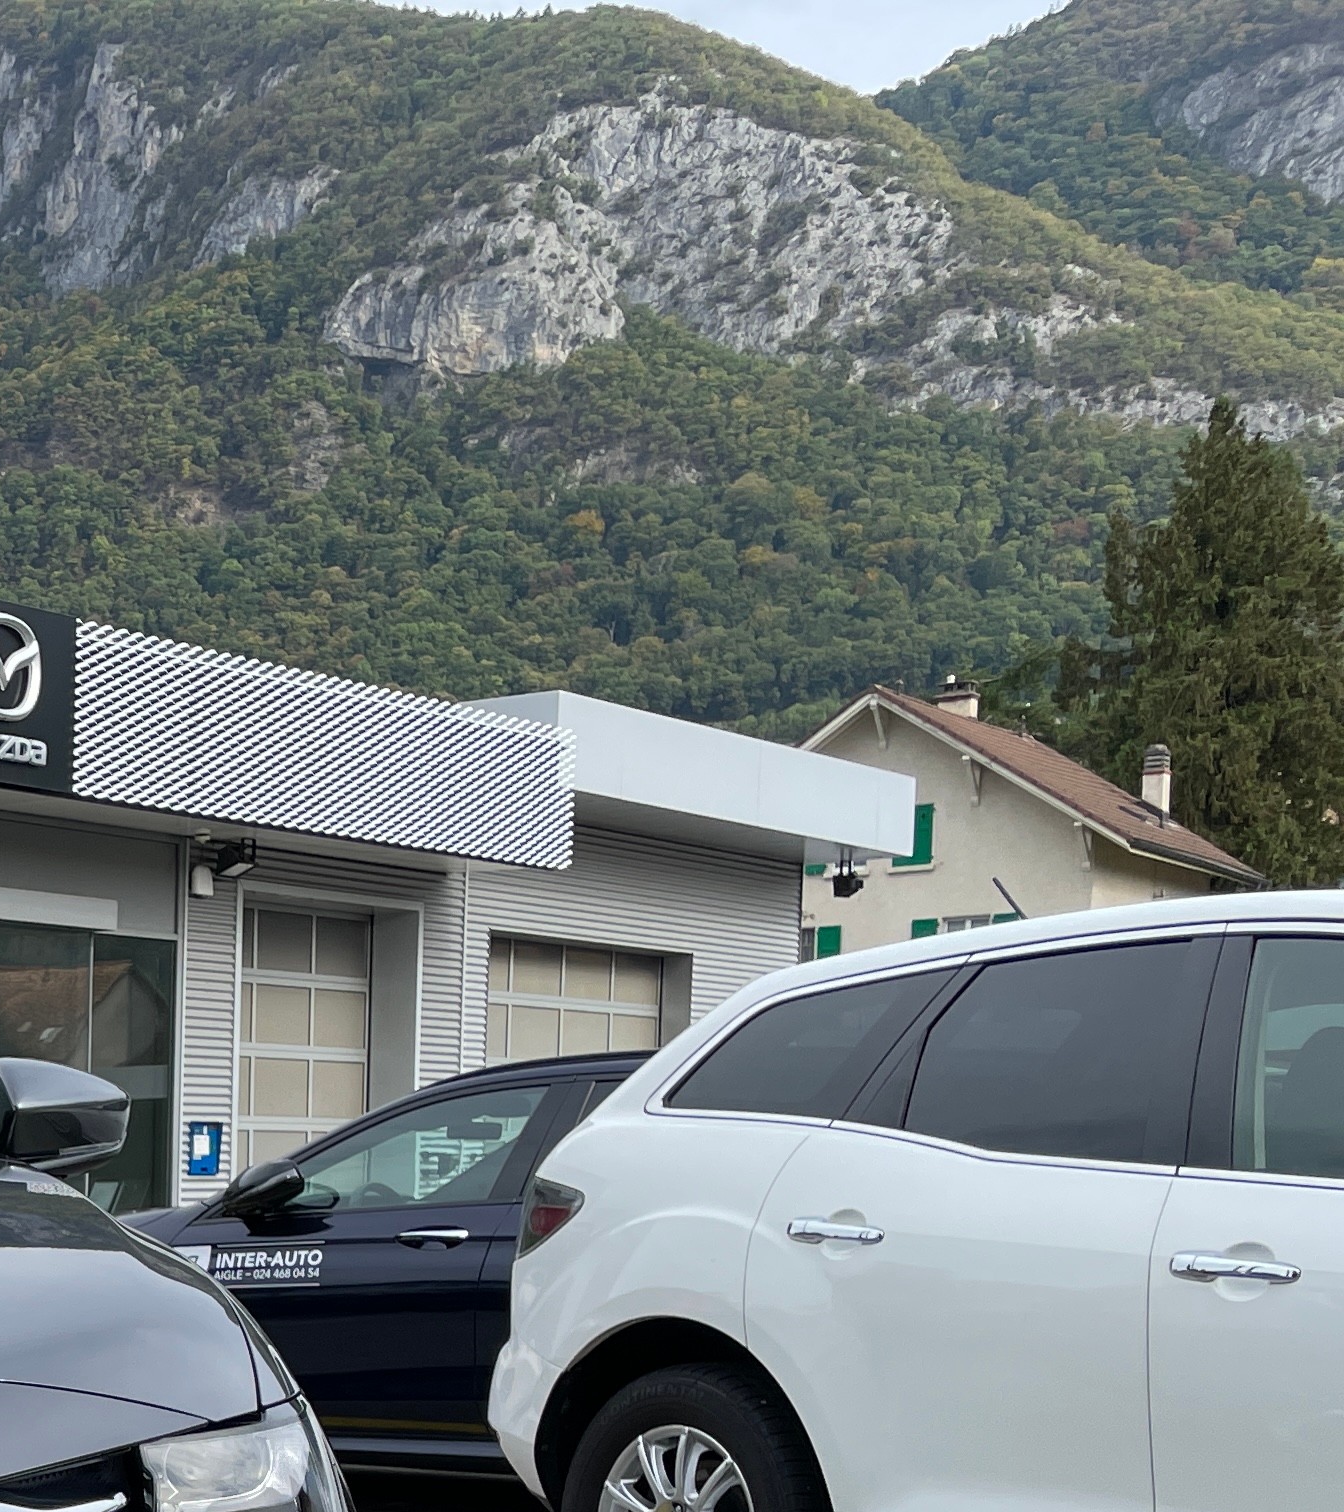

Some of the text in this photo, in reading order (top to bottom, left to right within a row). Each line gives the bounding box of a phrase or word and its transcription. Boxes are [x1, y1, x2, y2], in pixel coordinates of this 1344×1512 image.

[215, 1249, 323, 1269] INTER-AUTO
[214, 1269, 243, 1281] AIGLE
[253, 1268, 271, 1280] 024
[273, 1268, 291, 1279] 468
[293, 1267, 305, 1279] 04
